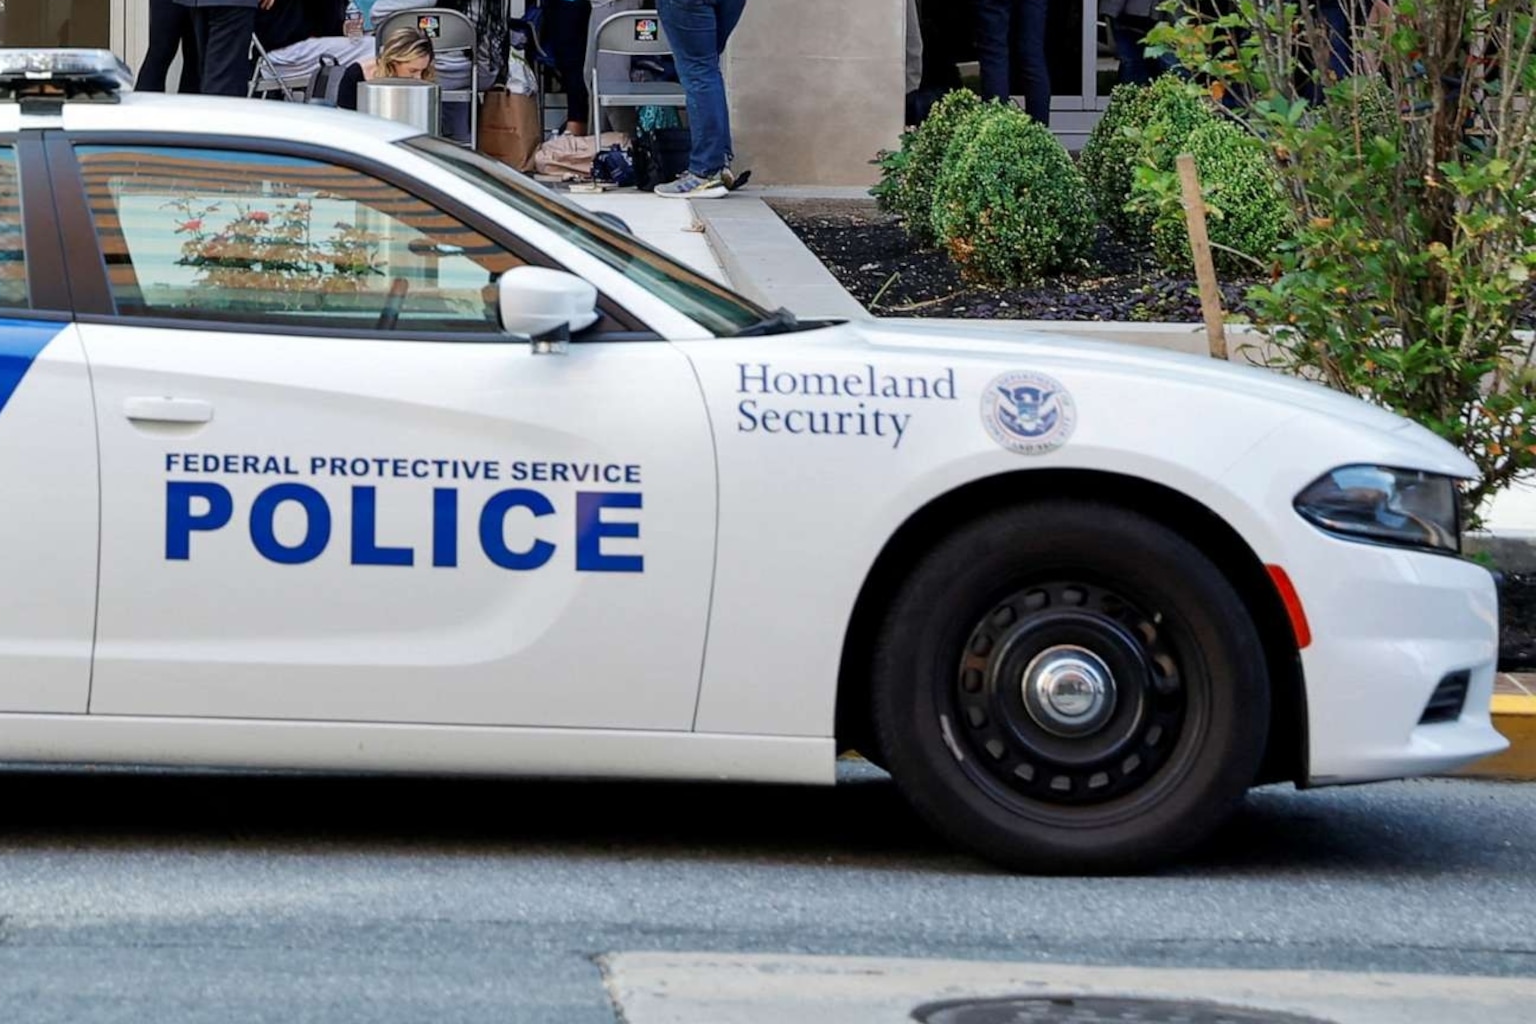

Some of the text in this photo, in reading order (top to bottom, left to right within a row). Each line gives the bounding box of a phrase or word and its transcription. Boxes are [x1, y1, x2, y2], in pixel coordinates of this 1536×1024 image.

[736, 363, 957, 400] Homeland
[738, 399, 912, 448] Security
[166, 453, 642, 483] FEDERAL PROTECTIVE SERVICE
[165, 480, 644, 573] POLICE
